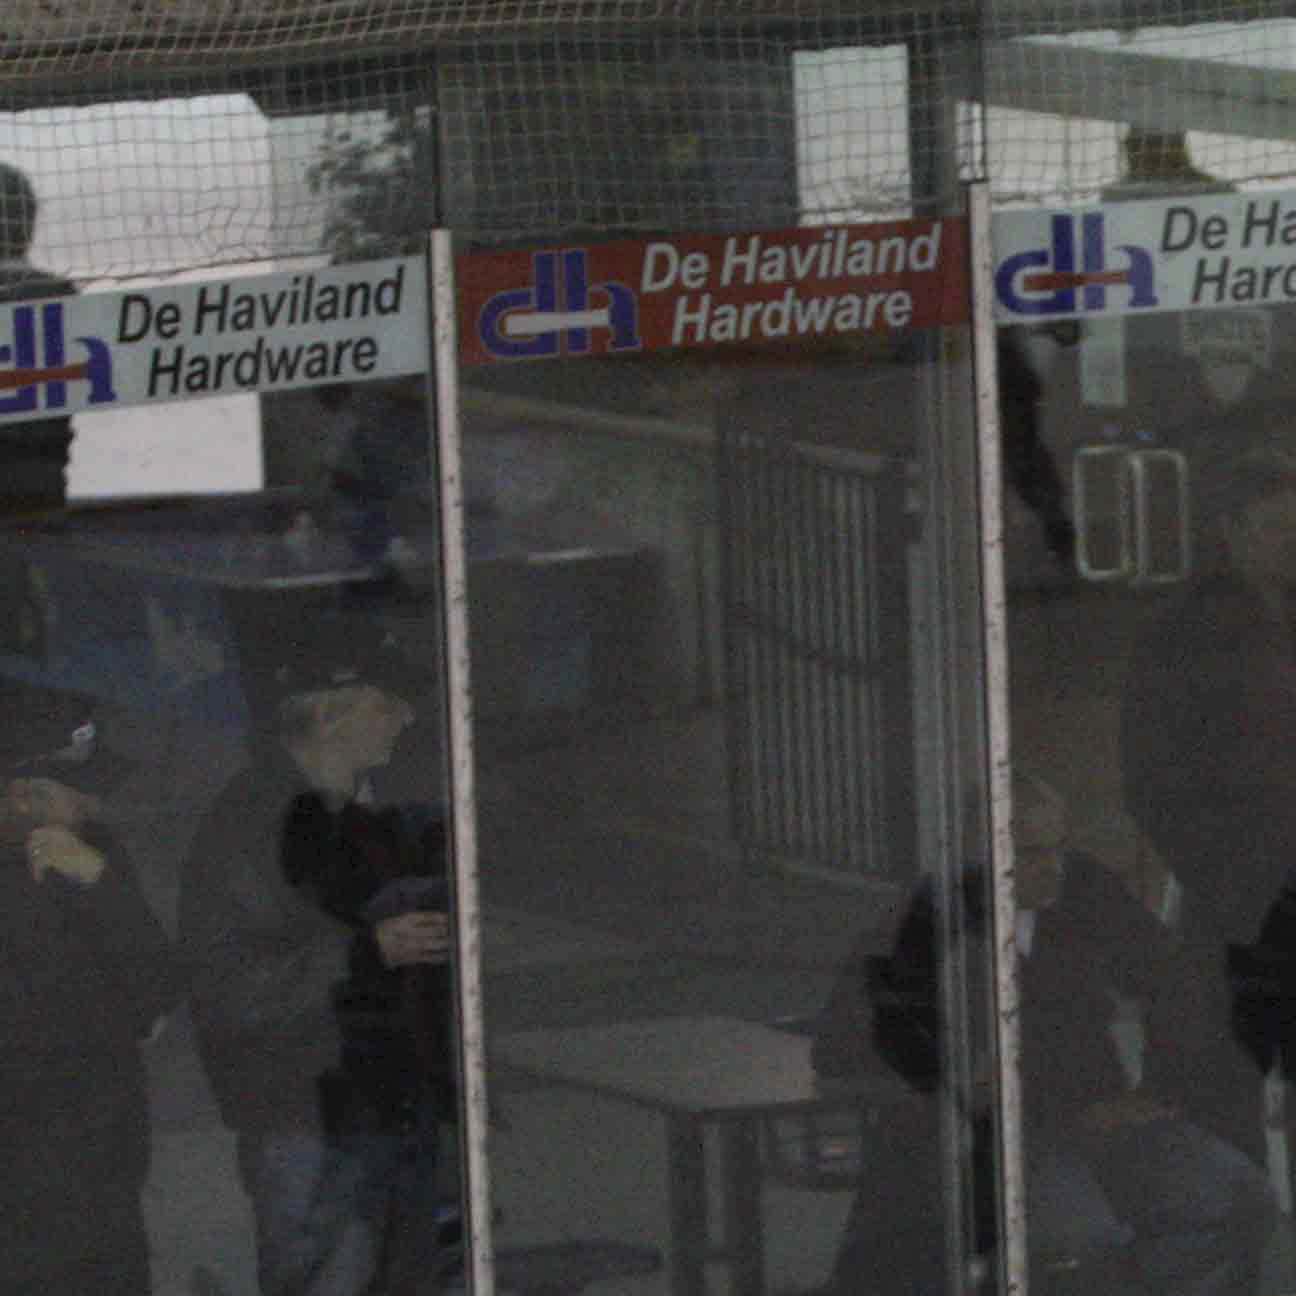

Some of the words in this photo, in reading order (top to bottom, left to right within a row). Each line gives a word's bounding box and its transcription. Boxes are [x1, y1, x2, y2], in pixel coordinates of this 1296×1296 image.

[640, 242, 709, 293] De
[720, 223, 943, 286] Haviland
[1161, 206, 1228, 252] De
[117, 293, 181, 344] De
[193, 265, 405, 336] Haviland
[671, 289, 913, 345] Hardware
[147, 336, 379, 397] Hardware
